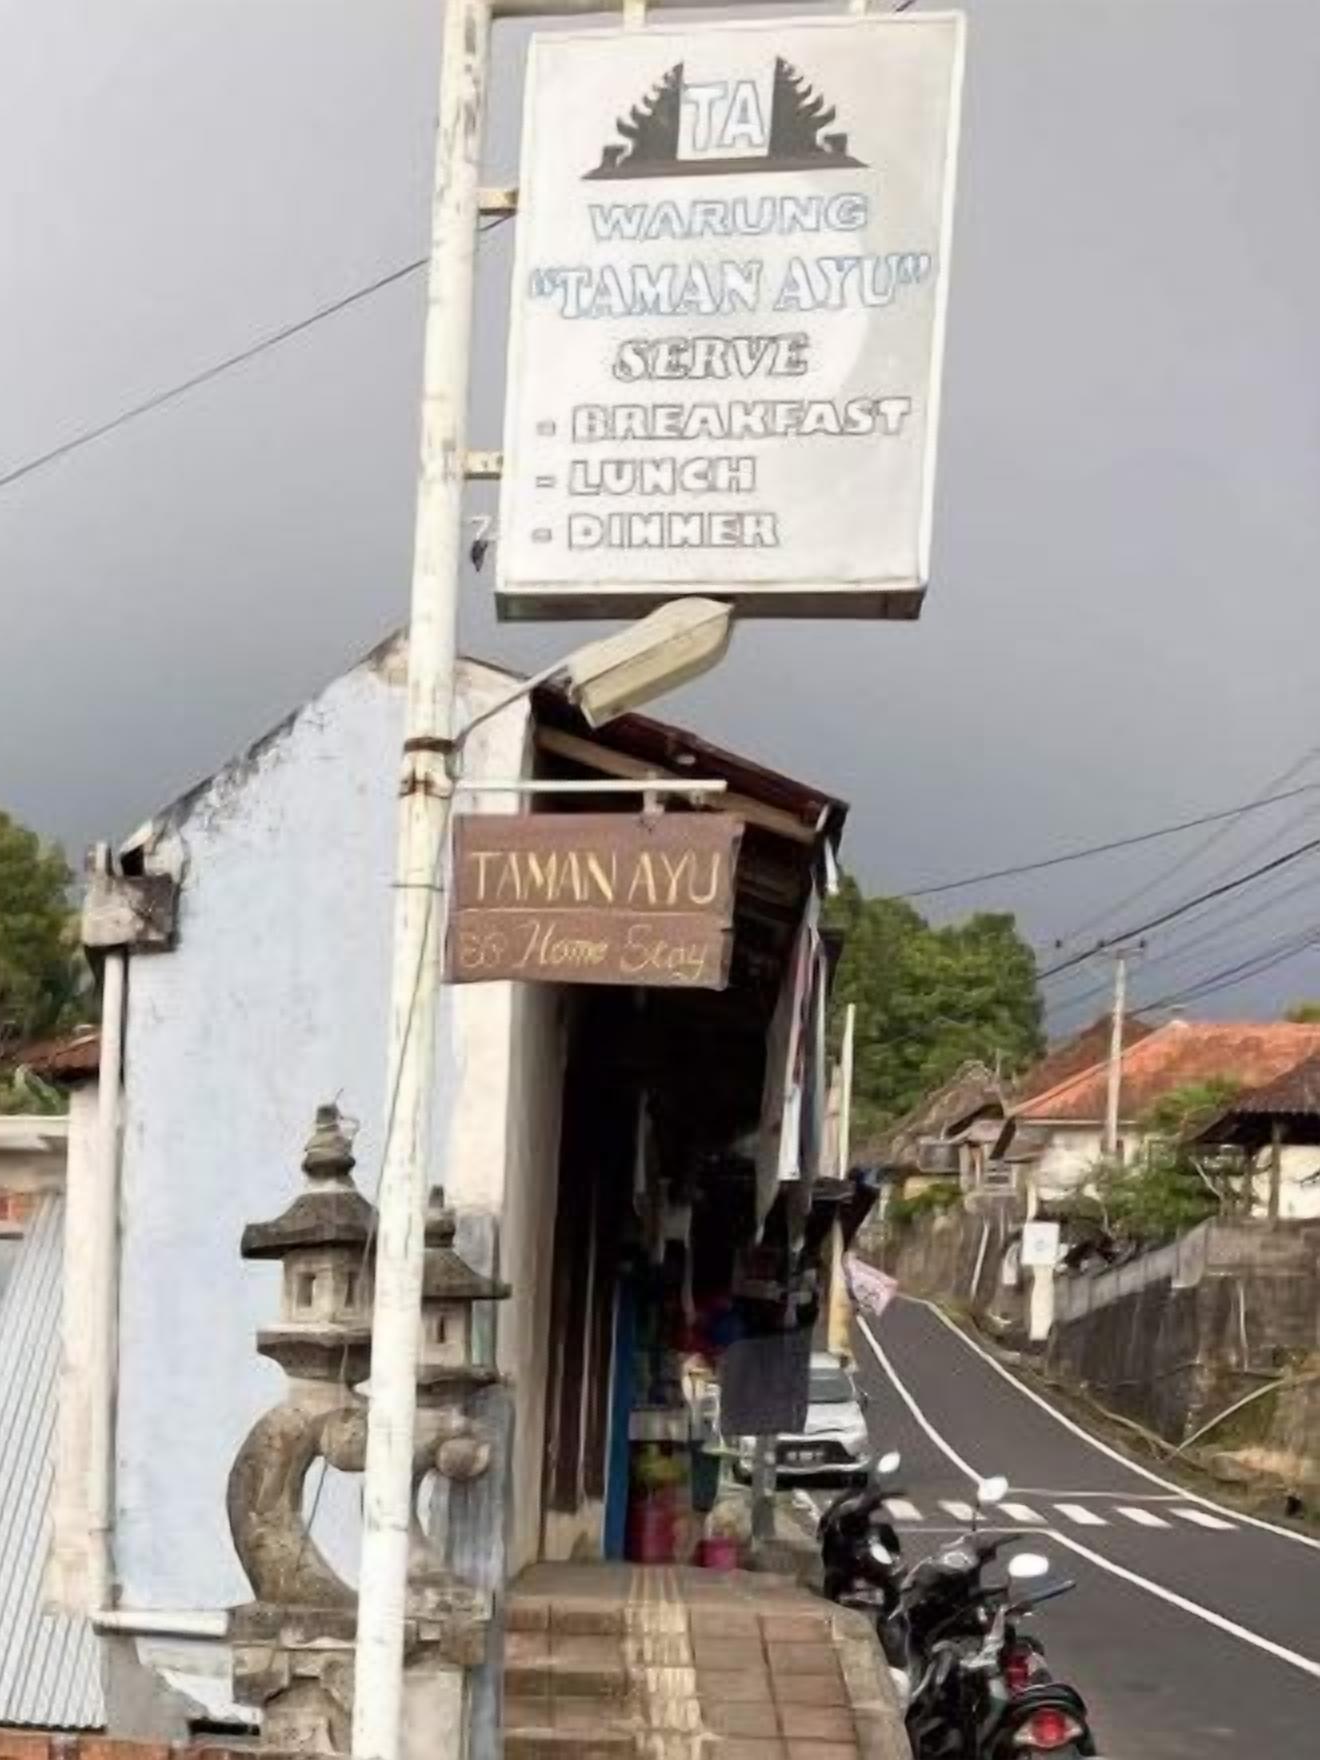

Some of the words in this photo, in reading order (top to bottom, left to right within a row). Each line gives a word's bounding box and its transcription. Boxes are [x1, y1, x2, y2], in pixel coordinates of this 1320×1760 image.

[681, 79, 769, 151] TA
[588, 192, 868, 241] WARUNG
[613, 332, 810, 382] SERVE
[572, 396, 913, 443] BREAKFAST
[568, 455, 757, 496] LUNCH
[567, 511, 781, 550] DINNER
[470, 851, 618, 902] TAMAN
[628, 850, 721, 905] AYU
[511, 919, 608, 968] Home
